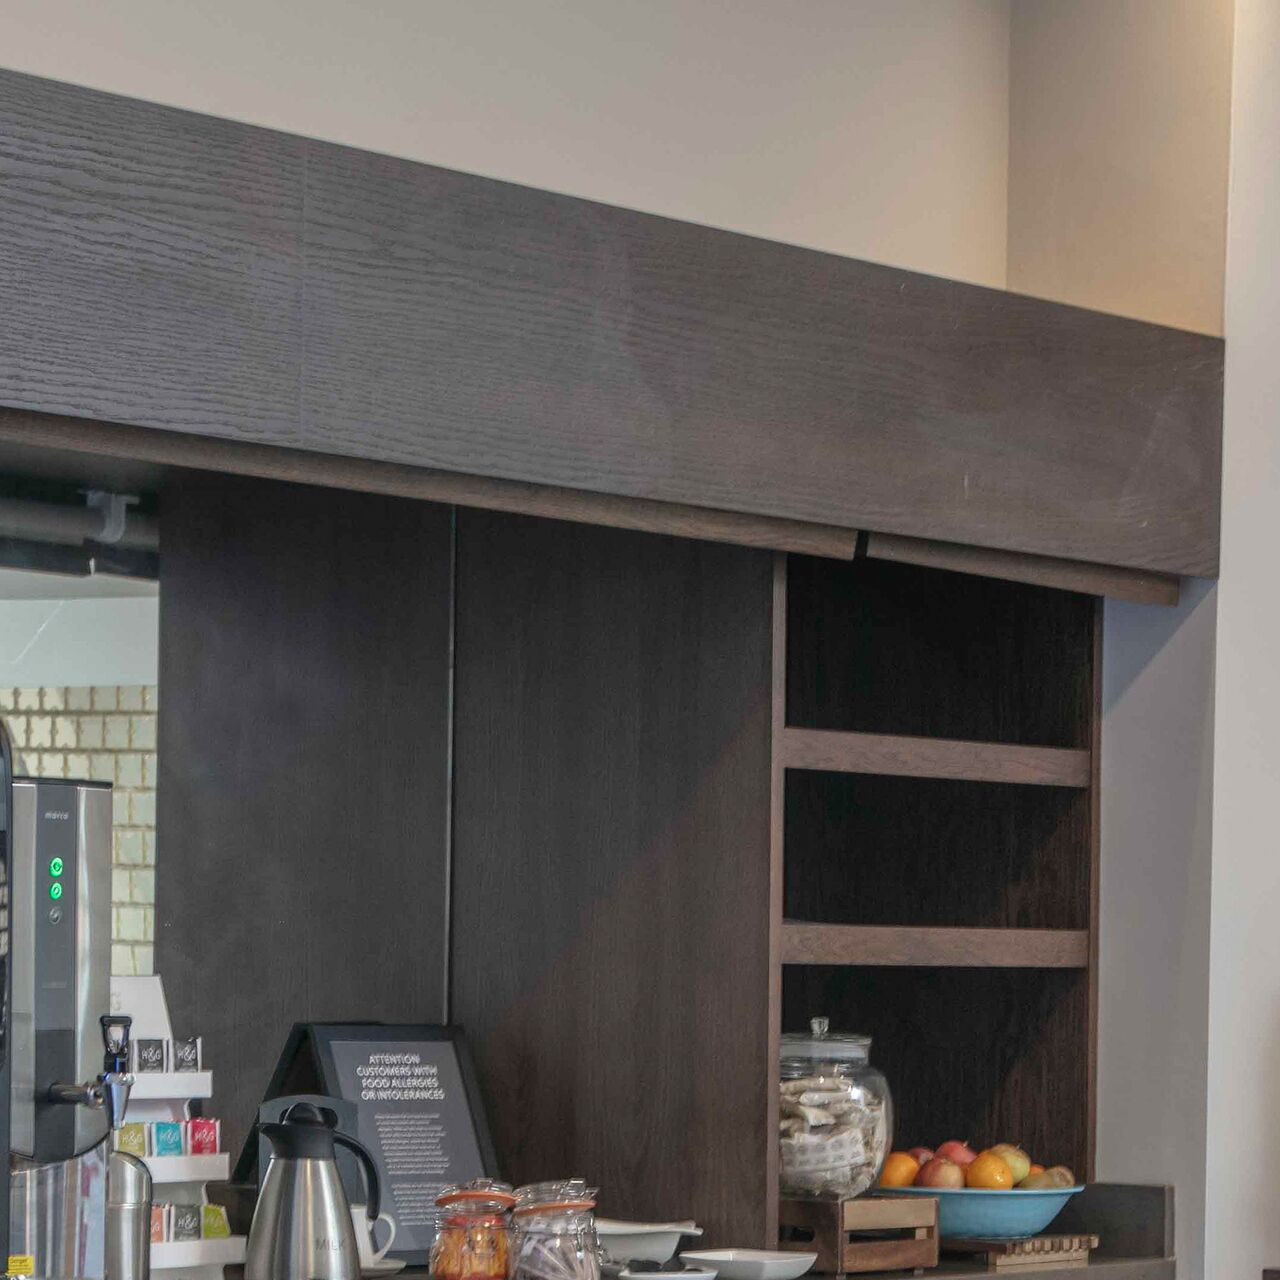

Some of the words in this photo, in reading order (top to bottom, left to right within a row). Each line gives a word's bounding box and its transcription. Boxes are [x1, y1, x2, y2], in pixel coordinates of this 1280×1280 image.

[141, 1046, 161, 1061] H&G
[369, 1053, 420, 1064] ATTENTION
[356, 1065, 411, 1076] CUSTOMERS
[412, 1064, 438, 1076] WITH
[361, 1077, 390, 1088] FOOD
[391, 1077, 439, 1088] ALLERGIES
[361, 1089, 375, 1100] OR
[377, 1088, 445, 1100] INTOLERANCES
